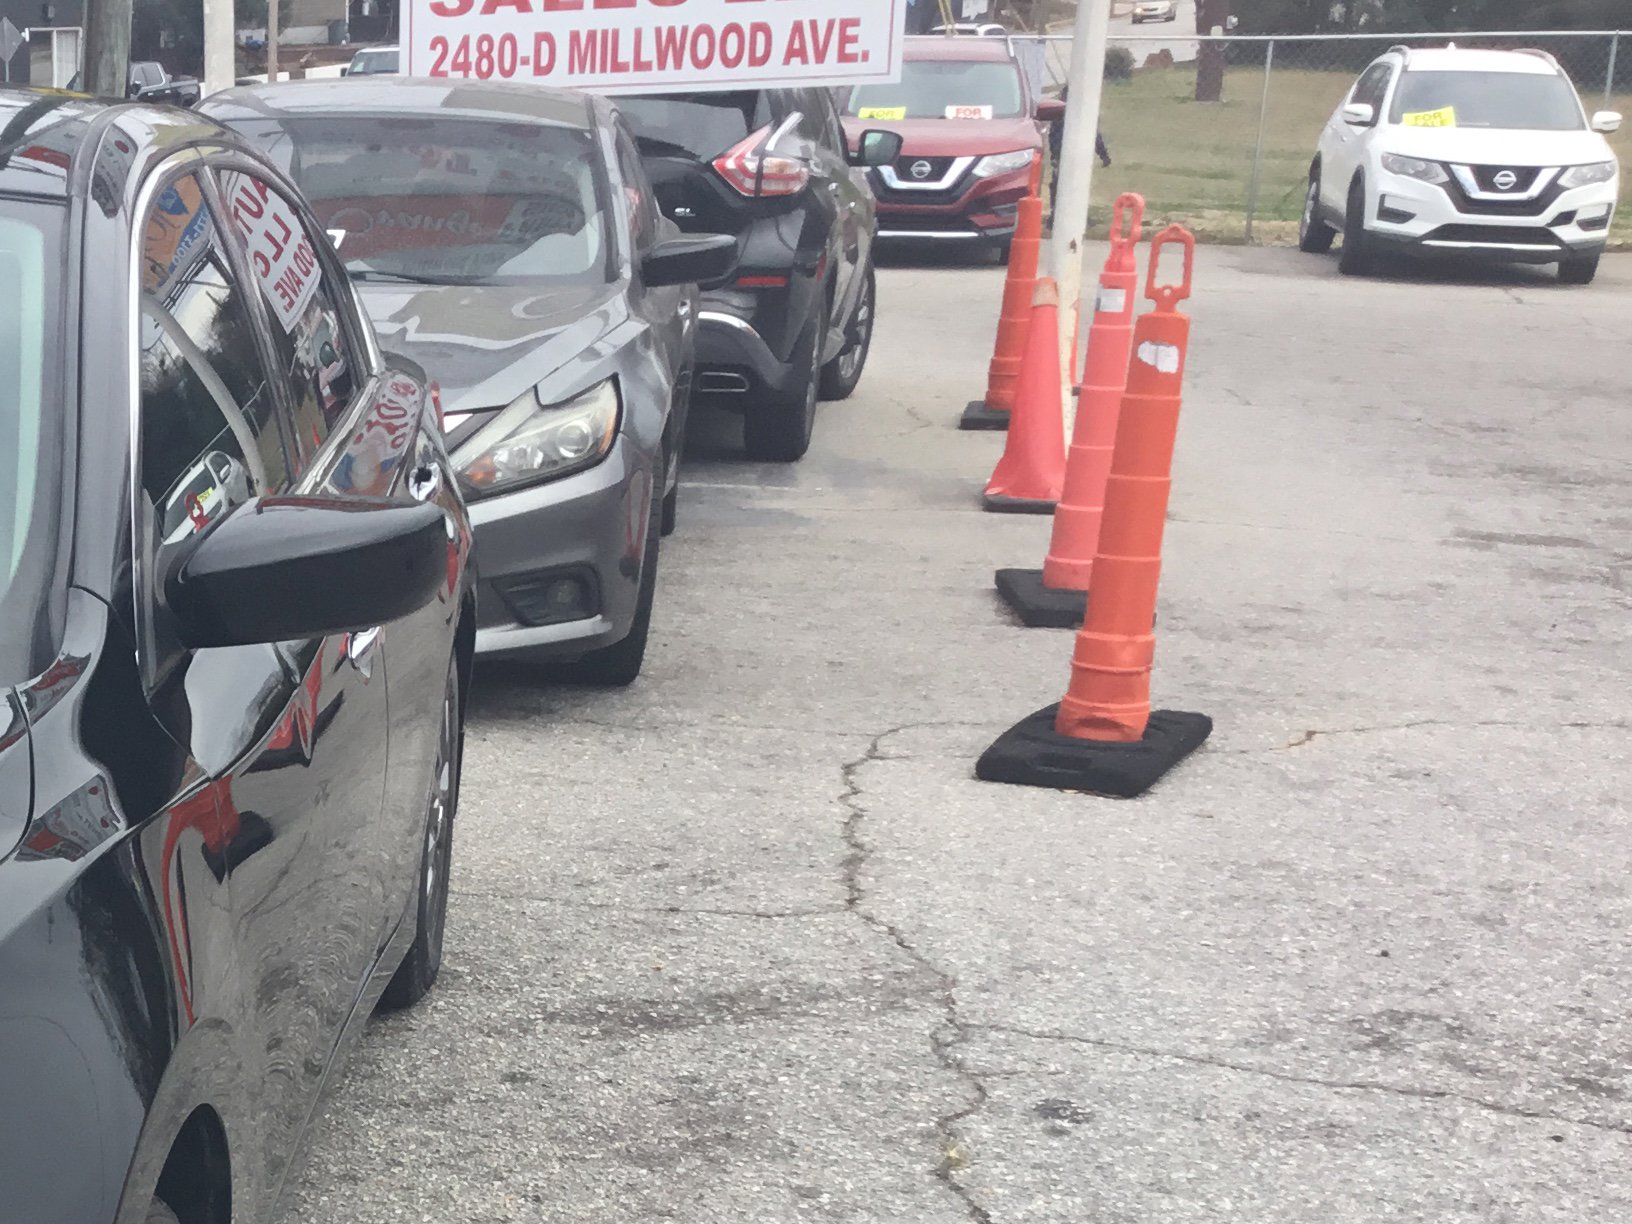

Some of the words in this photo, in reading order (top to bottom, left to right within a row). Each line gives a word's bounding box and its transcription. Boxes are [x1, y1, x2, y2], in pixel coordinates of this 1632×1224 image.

[429, 31, 557, 80] 2480-D
[568, 22, 773, 75] MILLWOOD
[782, 17, 870, 66] AVE.
[955, 107, 982, 118] FOR
[1414, 111, 1443, 123] FOR
